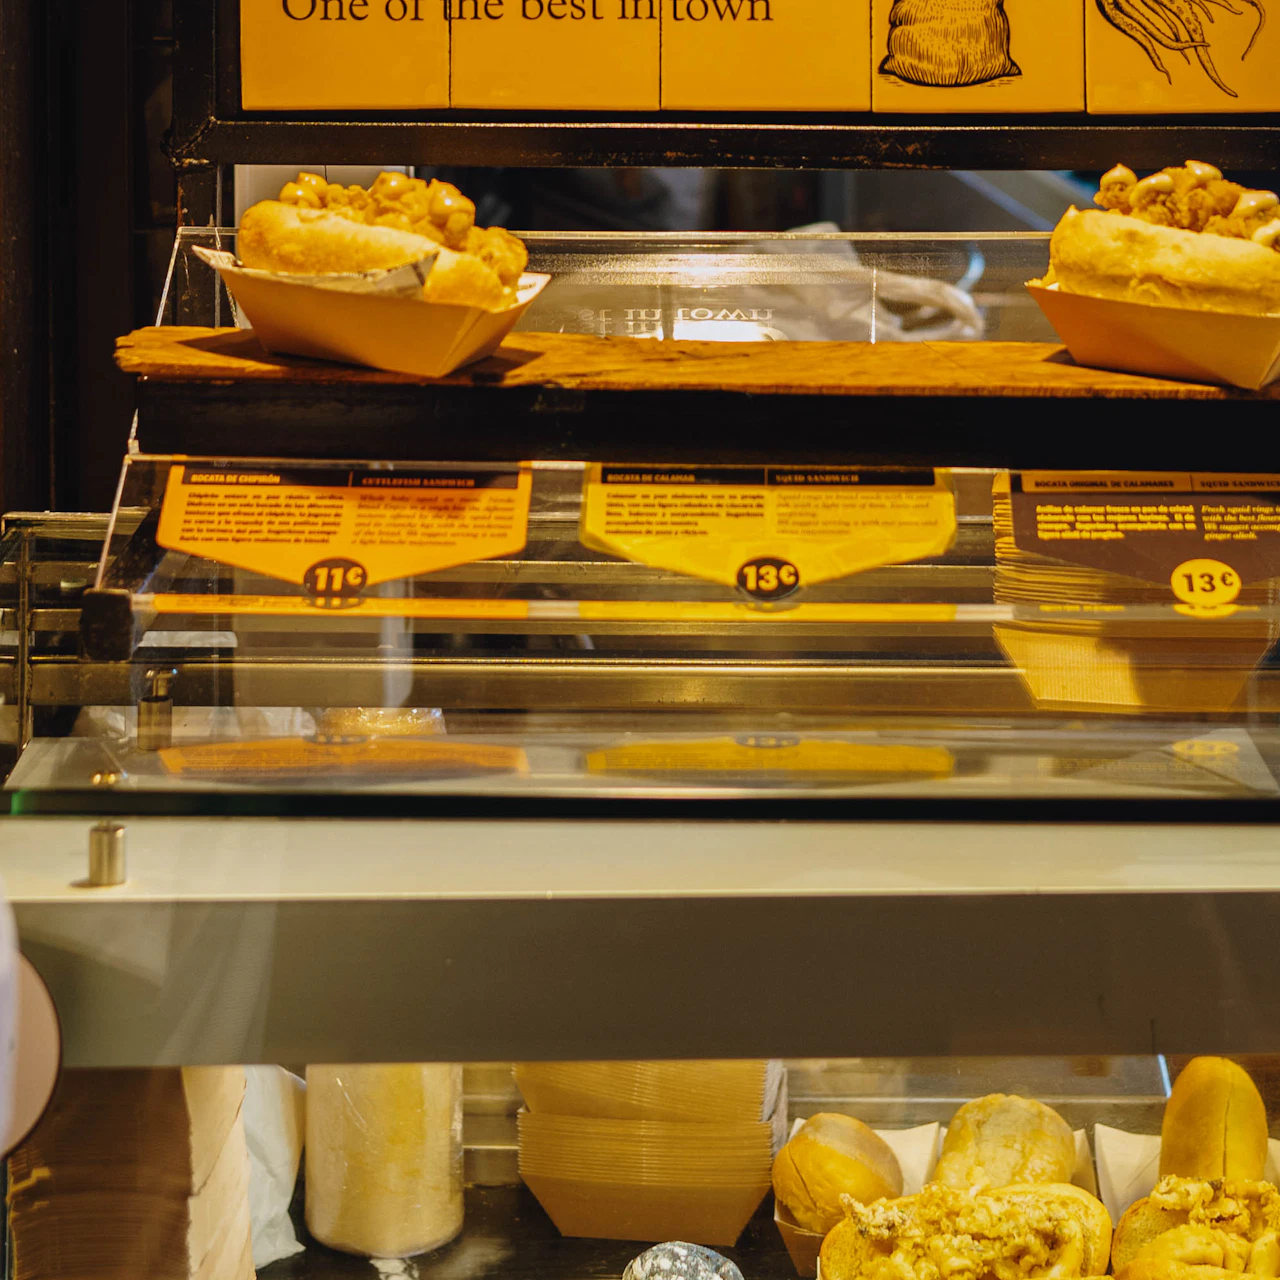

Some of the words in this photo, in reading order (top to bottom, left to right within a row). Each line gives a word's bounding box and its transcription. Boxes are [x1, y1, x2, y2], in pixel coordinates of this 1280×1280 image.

[190, 474, 224, 483] BOCATA
[225, 474, 237, 483] DE
[238, 475, 280, 484] CHIPIRÓN
[606, 473, 640, 482] BOCATA
[641, 473, 652, 482] DE
[1034, 479, 1067, 488] BOCATA
[1068, 479, 1107, 488] ORIGINAL
[1110, 480, 1121, 489] DE
[1123, 480, 1174, 489] CALAMARES
[1200, 479, 1229, 488] SQUID
[314, 566, 364, 592] 11€
[743, 564, 797, 592] 13€
[1181, 571, 1234, 593] 13€
